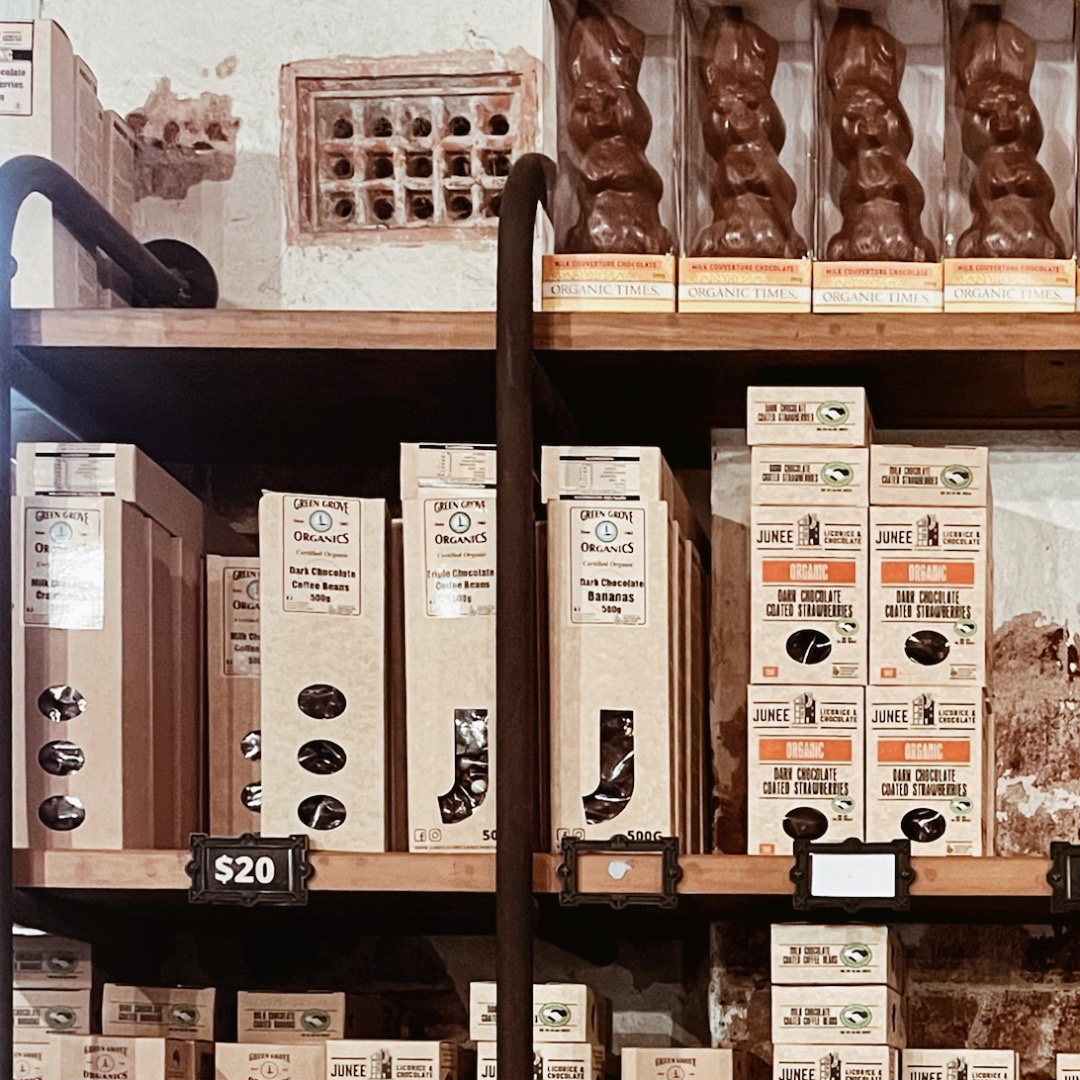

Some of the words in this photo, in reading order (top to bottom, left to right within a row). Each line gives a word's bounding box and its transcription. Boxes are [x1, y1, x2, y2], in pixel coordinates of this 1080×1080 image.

[551, 285, 614, 295] ORGANIC
[688, 288, 750, 298] ORGANIC
[294, 499, 319, 510] GREEN
[322, 500, 348, 514] GROVE
[434, 502, 457, 513] GREEN
[460, 501, 486, 512] GROVE
[580, 510, 605, 520] GREEN
[608, 511, 633, 523] GROVE
[294, 531, 349, 544] ORGANICS
[435, 533, 487, 544] ORGANICS
[757, 530, 793, 544] JUNEE
[876, 531, 912, 544] JUNEE
[581, 542, 634, 553] ORGANICS
[289, 567, 309, 575] Dark
[311, 568, 356, 578] Chocolate
[452, 569, 494, 577] Chocolate
[292, 580, 320, 590] Coffee
[322, 582, 349, 592] Beans
[464, 581, 490, 589] Beans
[580, 578, 598, 587] Dark
[601, 579, 644, 588] Chocolate
[310, 594, 330, 603] 500g
[588, 591, 634, 603] Bananas
[778, 590, 796, 602] DARK
[801, 590, 841, 603] CHOCOLATE
[602, 606, 621, 614] 500g
[766, 605, 793, 617] COATED
[798, 605, 853, 617] STRAWBERRIES
[753, 709, 789, 722] JUNEE
[872, 710, 908, 723] JUNEE
[215, 854, 275, 884] $20
[331, 1064, 366, 1077] JUNEE
[779, 1068, 815, 1080] JUNEE
